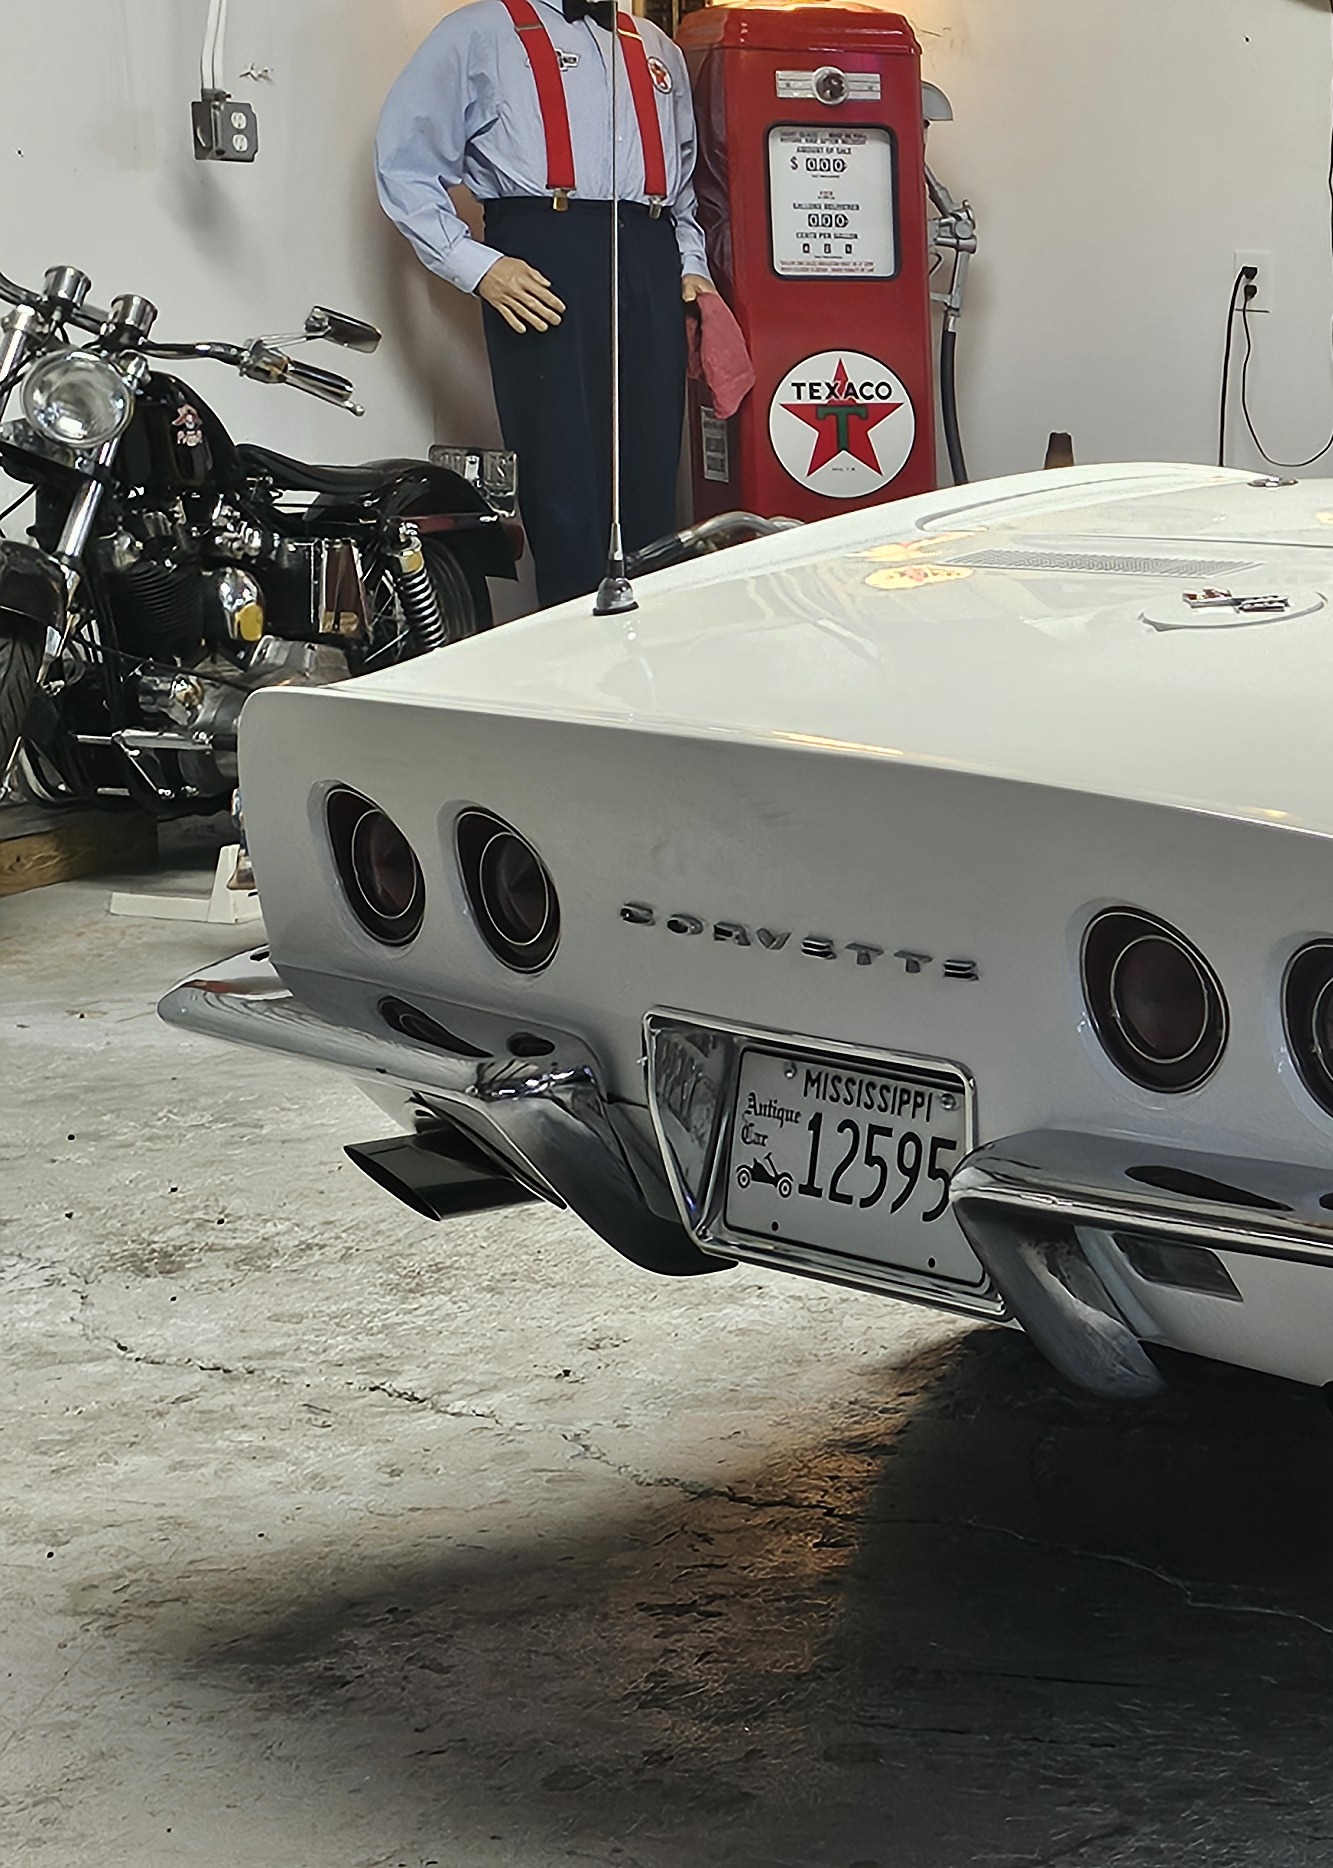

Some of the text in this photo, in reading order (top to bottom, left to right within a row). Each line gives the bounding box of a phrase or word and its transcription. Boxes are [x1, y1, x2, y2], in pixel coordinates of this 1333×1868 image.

[791, 381, 893, 401] TEXACO
[619, 902, 980, 982] CORVETTE
[746, 1092, 802, 1129] Antique
[803, 1069, 934, 1123] MISSISSIPPI
[741, 1123, 769, 1147] Car
[798, 1111, 958, 1223] 12595
